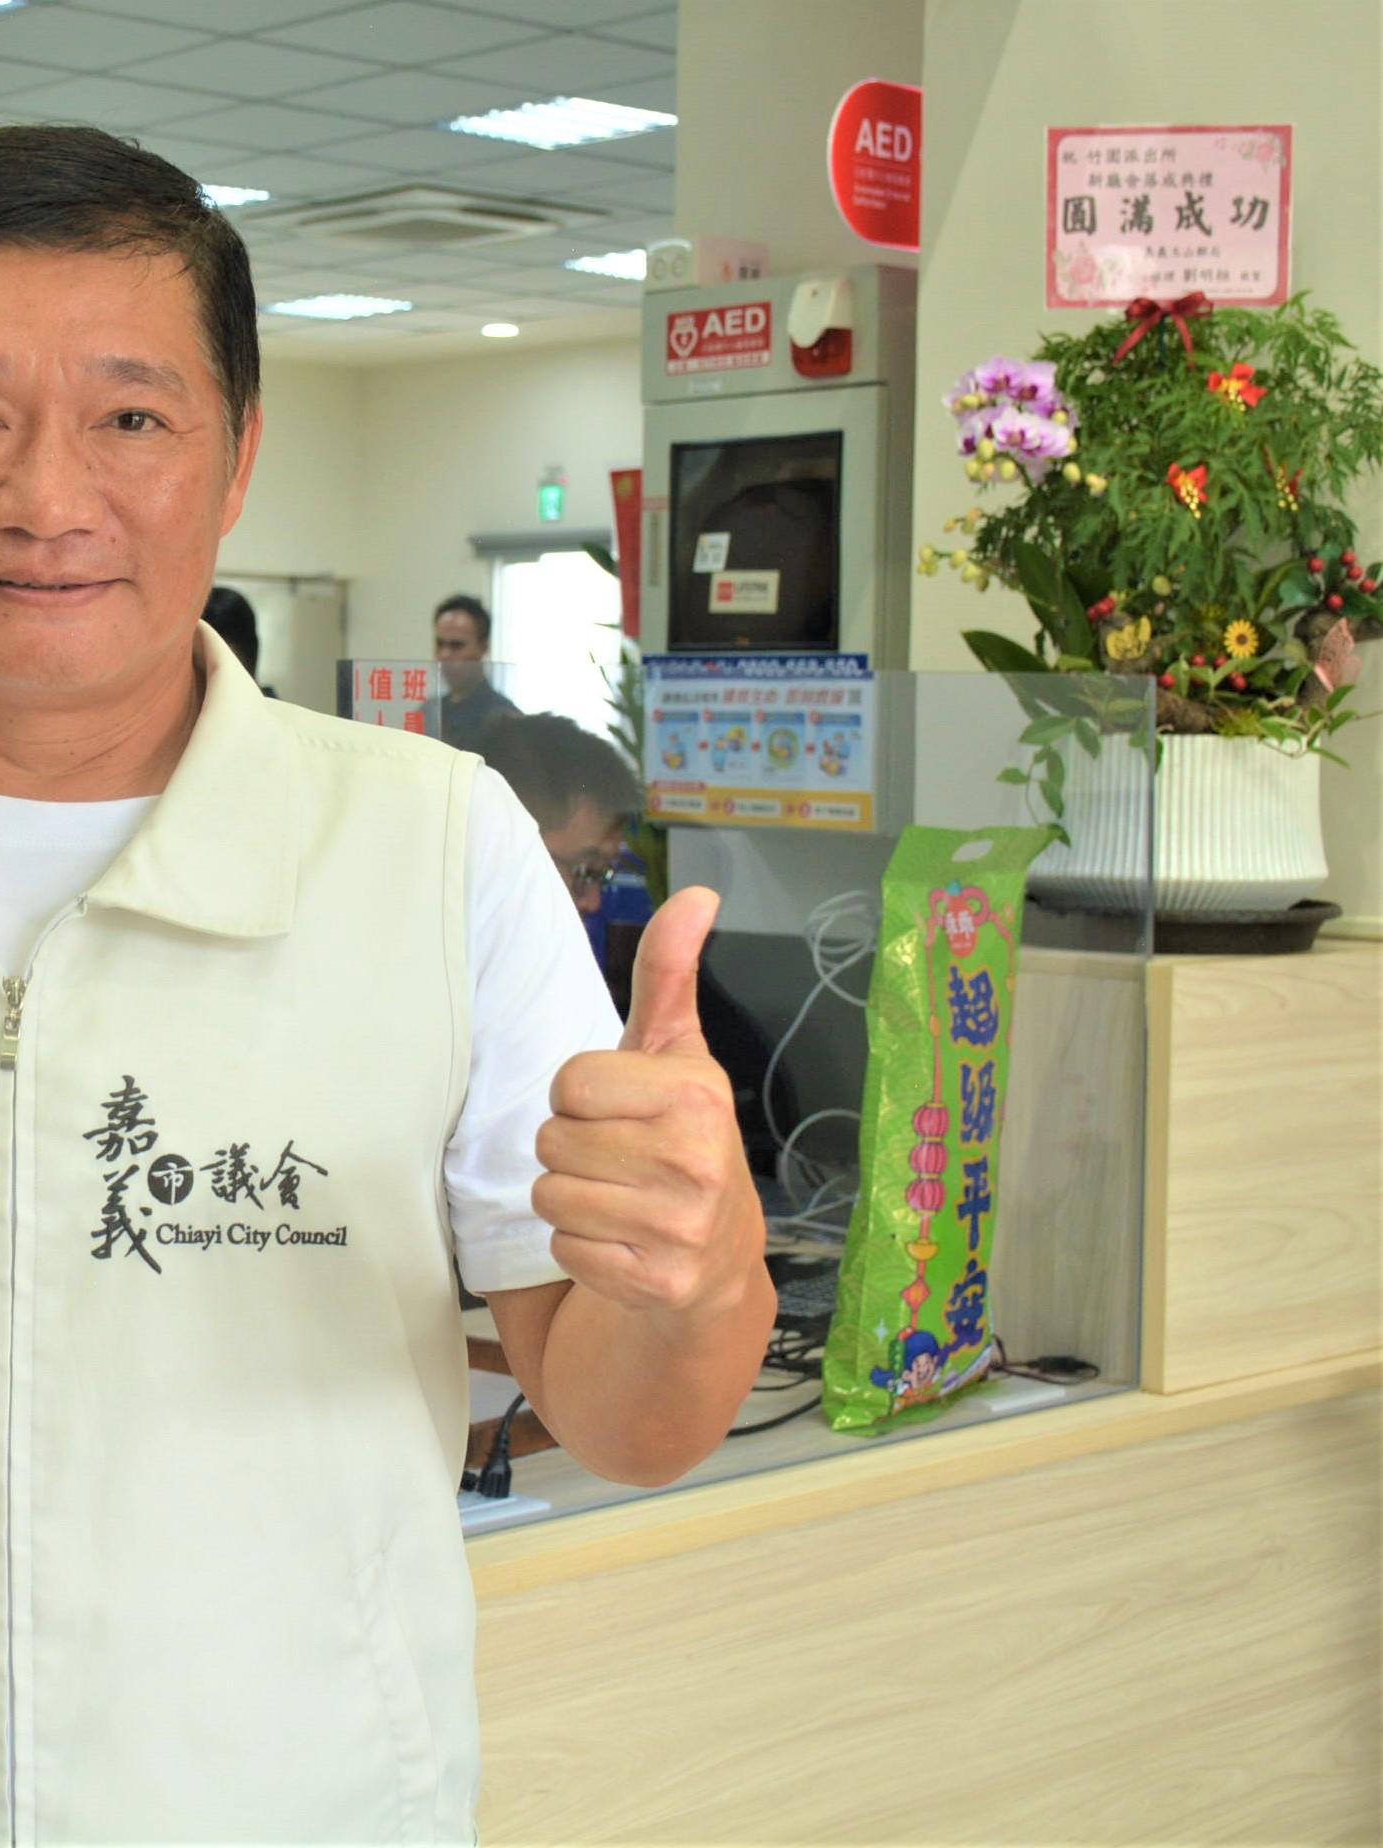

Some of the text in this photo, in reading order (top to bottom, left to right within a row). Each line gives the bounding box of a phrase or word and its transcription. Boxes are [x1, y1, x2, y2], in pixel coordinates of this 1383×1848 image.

[854, 117, 913, 162] AED
[1063, 191, 1270, 236] 圓滿成功
[701, 306, 767, 339] AED
[369, 667, 427, 701] 值班
[82, 1075, 162, 1274] 嘉義
[155, 1223, 348, 1252] Chiayi City Council
